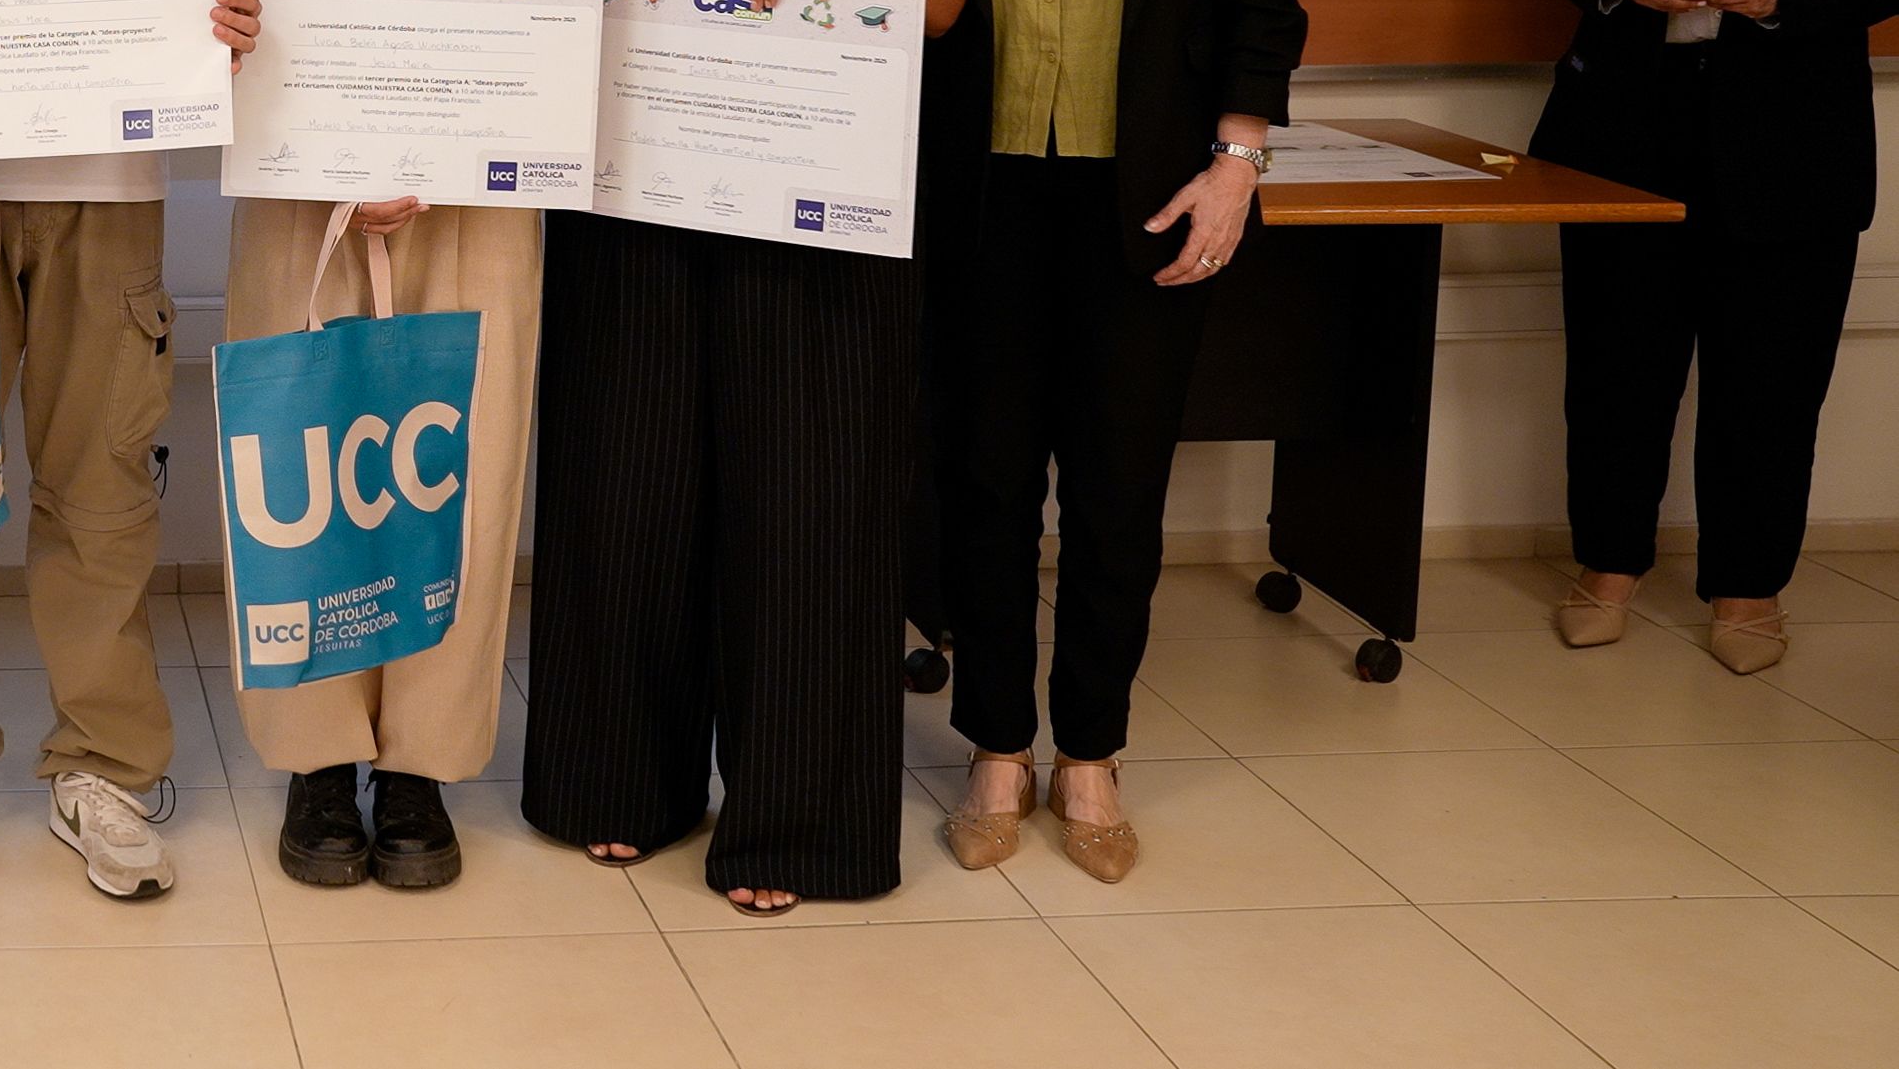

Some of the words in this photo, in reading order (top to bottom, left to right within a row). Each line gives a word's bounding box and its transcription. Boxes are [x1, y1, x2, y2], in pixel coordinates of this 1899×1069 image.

[0, 42, 30, 50] NUESTRA
[157, 104, 219, 114] UNIVERSIDAD
[125, 119, 151, 130] UCC
[158, 113, 201, 123] CATÓLICA
[158, 124, 170, 132] DE
[172, 121, 217, 131] CÓRDOBA
[522, 161, 583, 170] UNIVERSIDAD
[489, 171, 515, 181] UCC
[522, 169, 564, 178] CATÓLICA
[522, 178, 533, 186] DE
[535, 178, 579, 187] CÓRDOBA
[797, 208, 822, 222] UCC
[829, 210, 873, 224] CATÓLICA
[830, 202, 892, 218] UNIVERSIDAD
[828, 220, 840, 228] DE
[842, 220, 888, 235] CÓRDOBA
[229, 401, 462, 549] UCC
[317, 575, 396, 611] UNIVERSIDAD
[317, 600, 380, 627] CATÓLICA
[254, 623, 304, 644] UCC
[314, 628, 334, 644] DE
[338, 610, 399, 639] CÓRDOBA
[313, 638, 363, 654] JESUITAS
